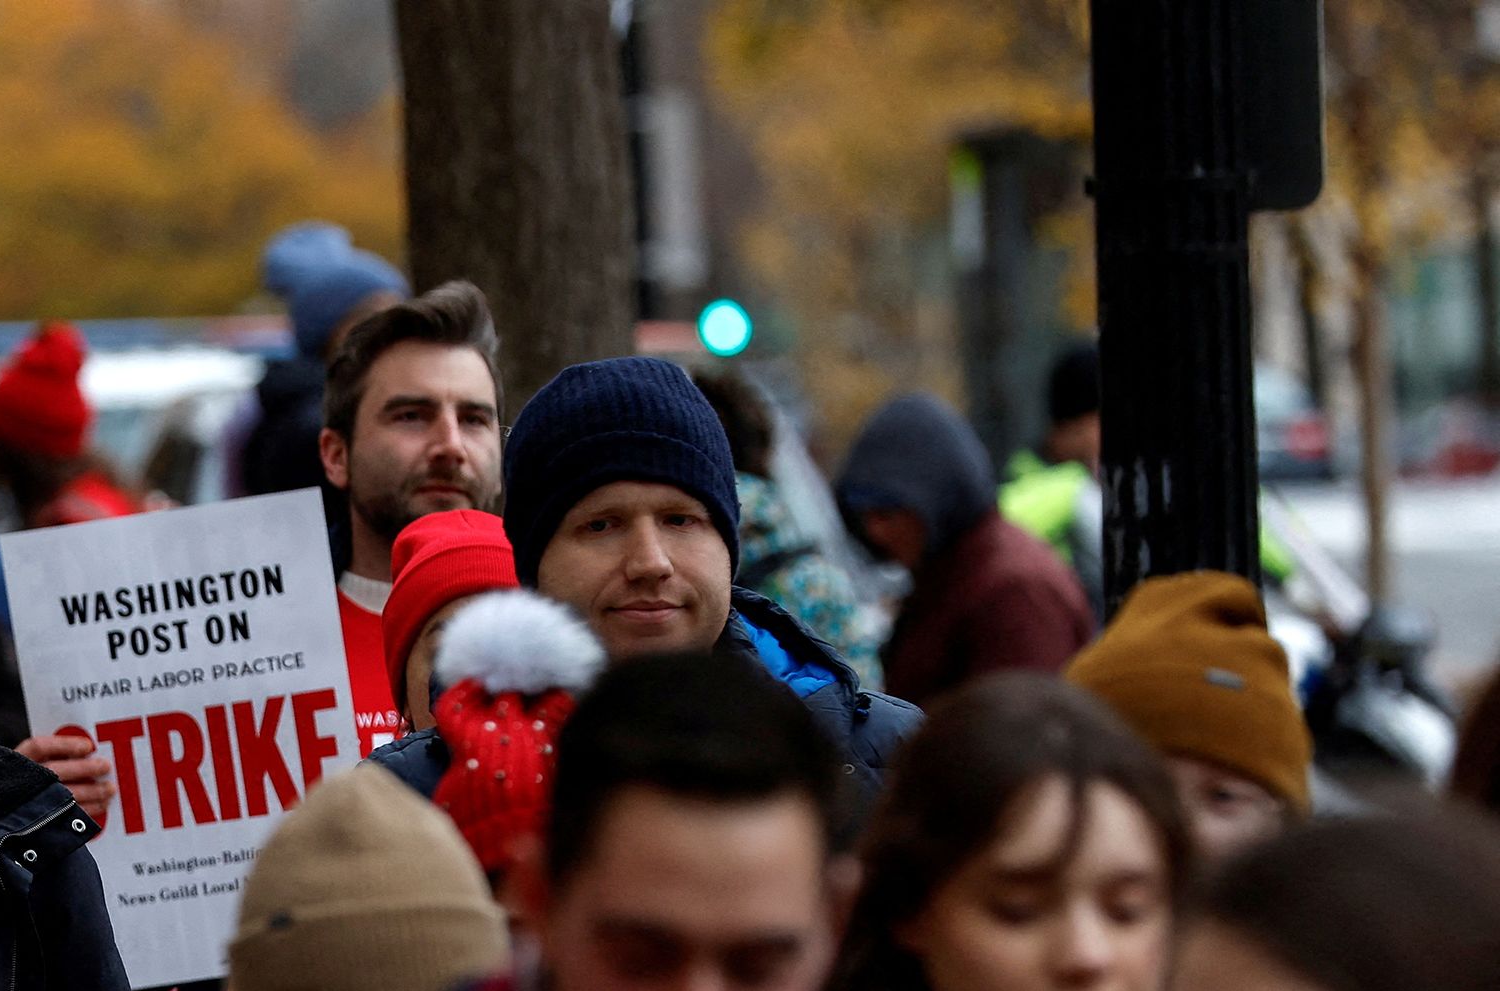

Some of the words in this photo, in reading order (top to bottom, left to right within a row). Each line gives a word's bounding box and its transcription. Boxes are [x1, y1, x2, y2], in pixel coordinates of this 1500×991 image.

[60, 563, 285, 626] WASHINGTON
[107, 620, 189, 660] POST
[205, 611, 251, 645] ON
[62, 678, 132, 704] UNFAIR
[137, 667, 204, 692] LABOR
[213, 652, 305, 680] PRACTICE
[118, 890, 155, 906] News
[159, 885, 198, 902] Guild
[202, 878, 239, 897] Local
